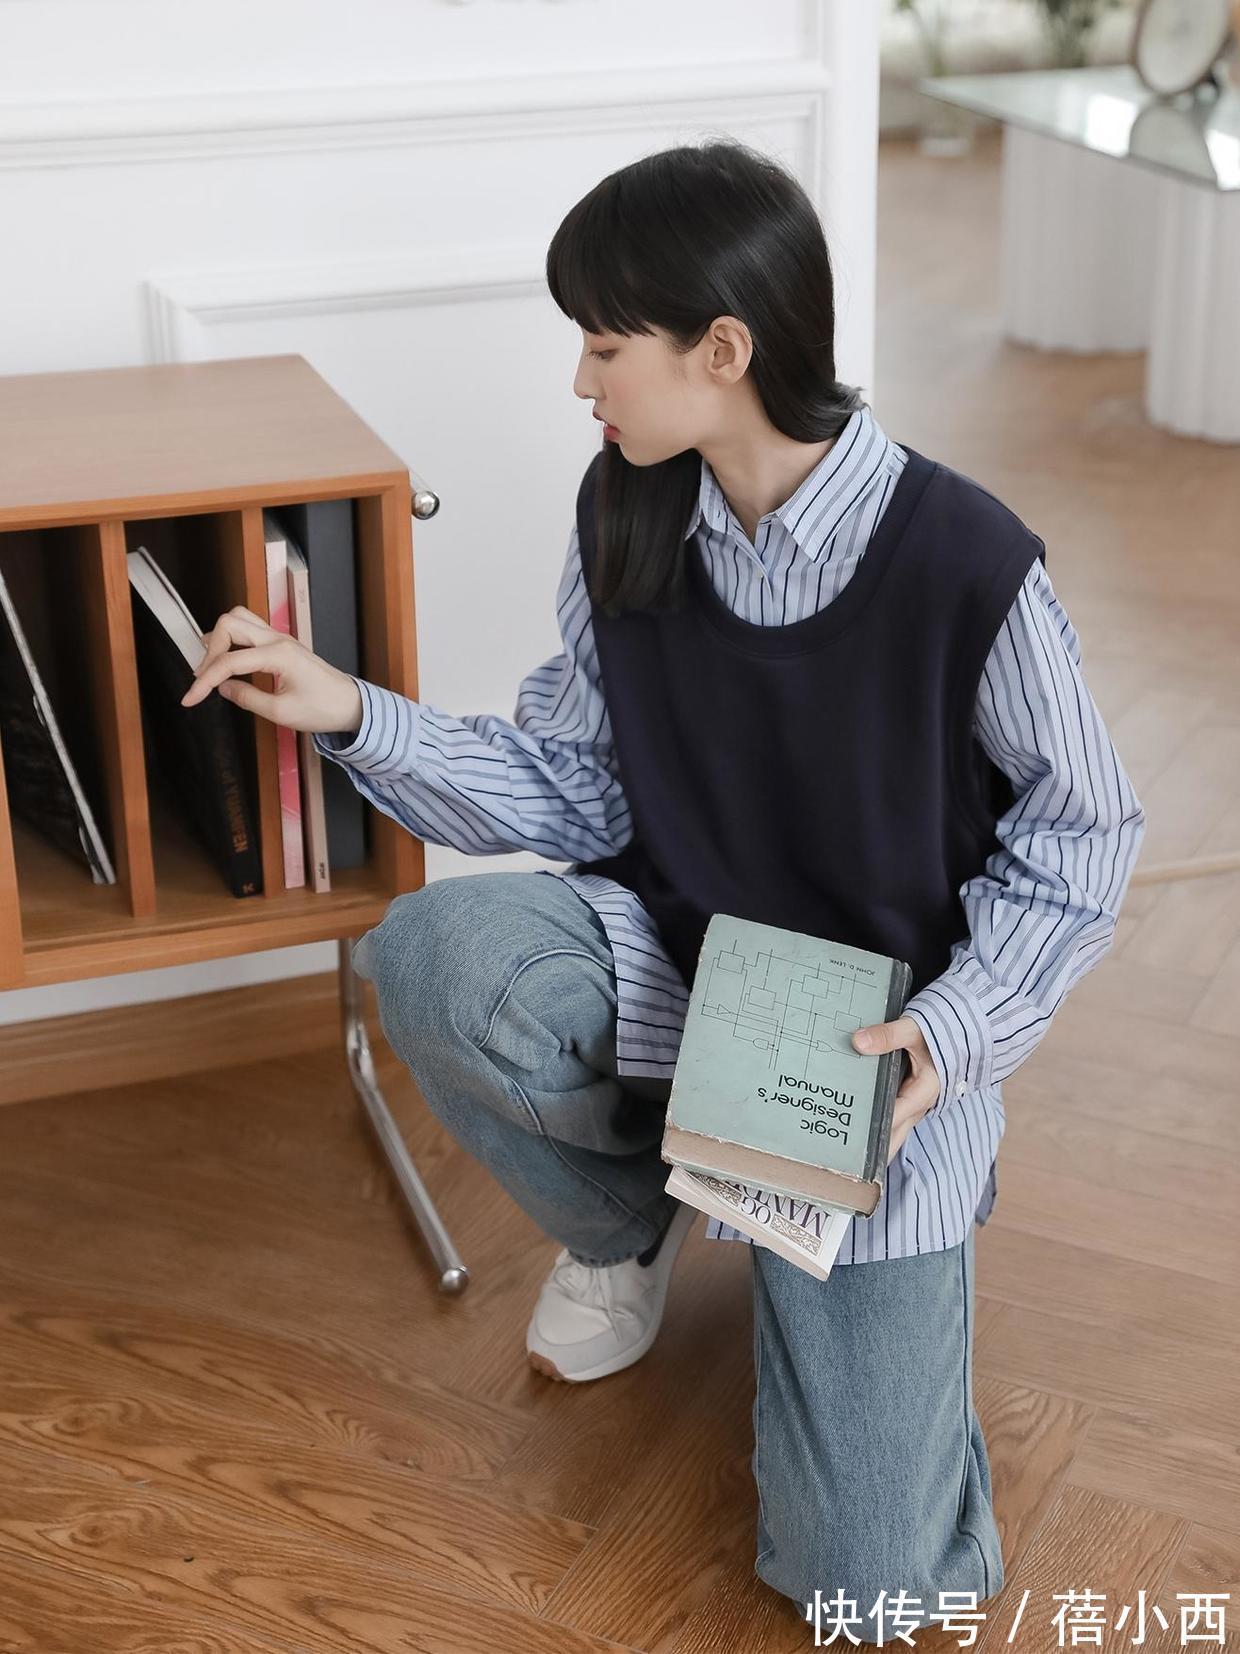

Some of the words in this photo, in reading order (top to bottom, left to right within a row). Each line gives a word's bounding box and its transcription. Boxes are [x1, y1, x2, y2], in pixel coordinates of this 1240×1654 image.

[829, 959, 846, 968] LENK
[856, 966, 876, 976] JOHN
[778, 1074, 854, 1108] Manual
[757, 1087, 852, 1127] Designer's
[800, 1118, 848, 1146] Logic
[739, 1196, 772, 1225] OG
